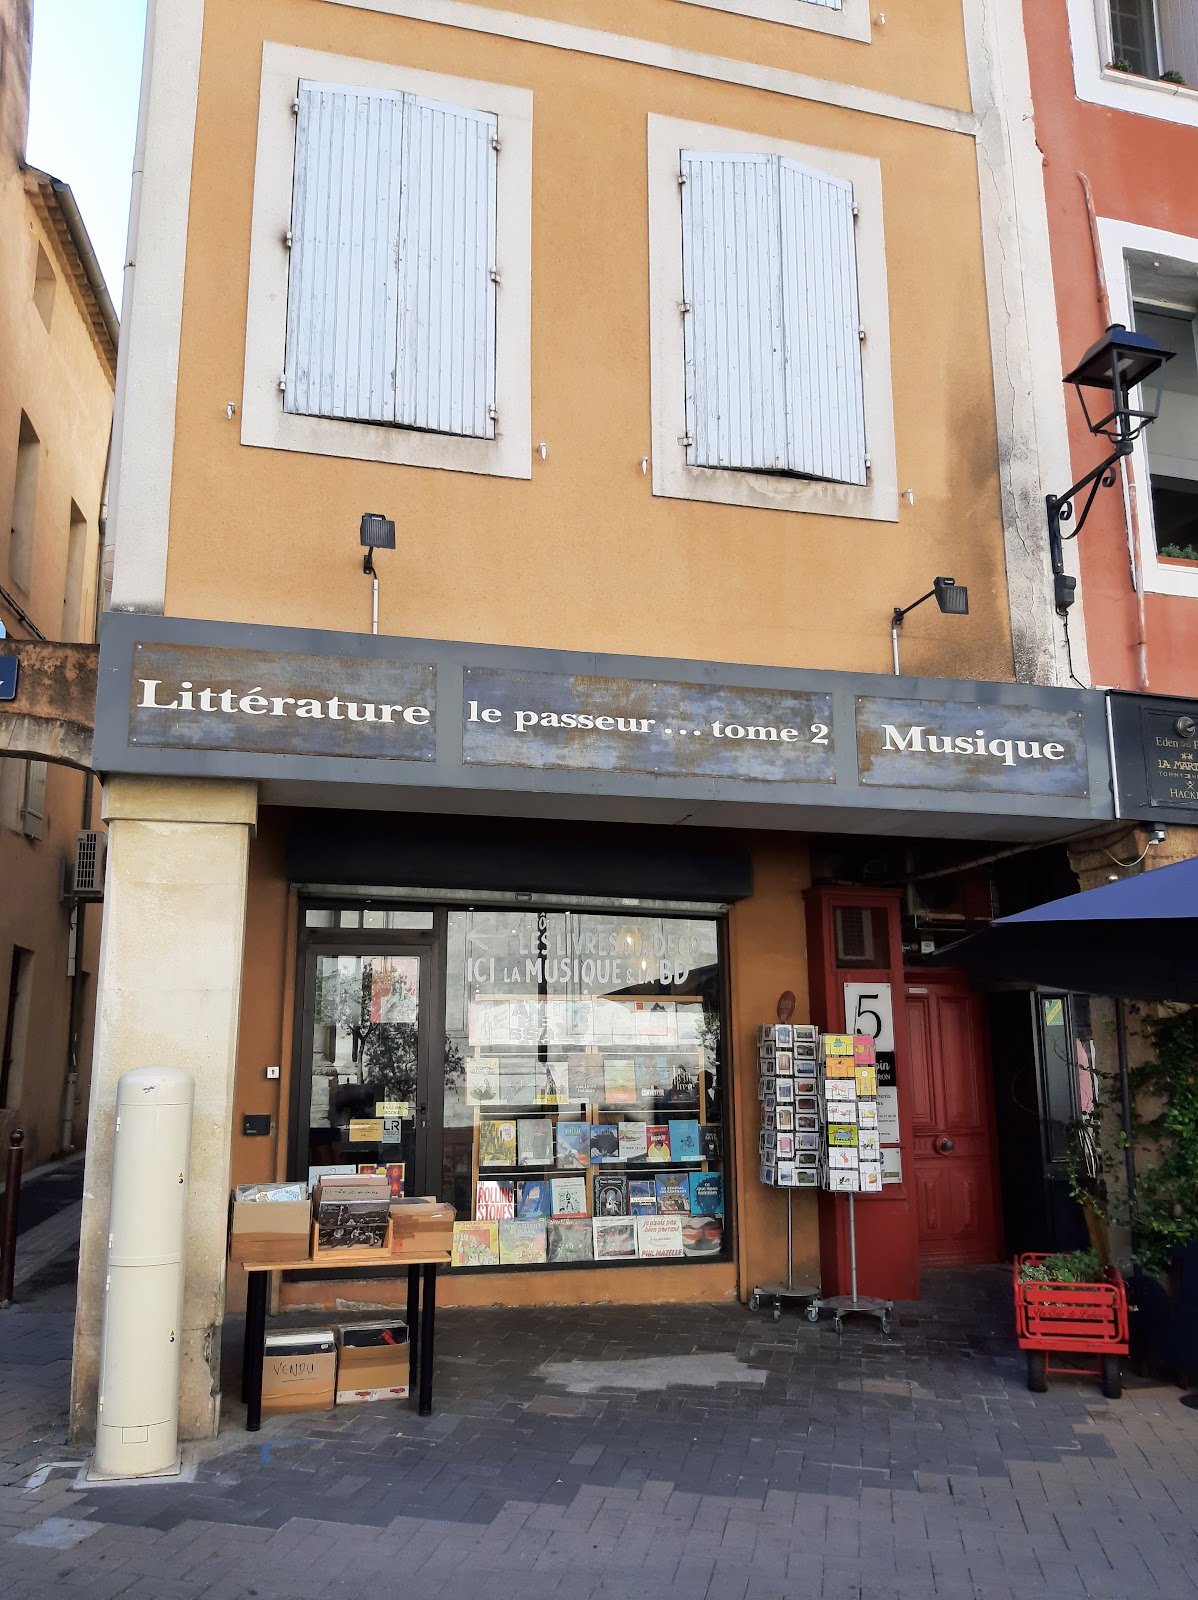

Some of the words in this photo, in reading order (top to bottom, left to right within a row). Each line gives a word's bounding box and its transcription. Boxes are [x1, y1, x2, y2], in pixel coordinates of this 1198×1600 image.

[136, 678, 431, 725] Littérature
[467, 700, 502, 723] le
[513, 708, 656, 733] passeur
[711, 719, 799, 743] tome
[810, 723, 829, 746] 2
[880, 723, 1065, 766] Musique
[1156, 737, 1178, 748] Eden
[518, 931, 551, 955] LES
[556, 931, 619, 956] LIVRES
[467, 957, 495, 983] ICI
[503, 967, 521, 983] LA
[525, 957, 622, 986] MUSIQUE
[626, 967, 635, 984] &
[638, 967, 654, 985] LA
[659, 958, 689, 985] BD
[854, 993, 882, 1039] 5
[477, 1186, 514, 1204] ROLLING
[477, 1203, 514, 1220] STONES
[273, 1362, 314, 1377] VENDU
